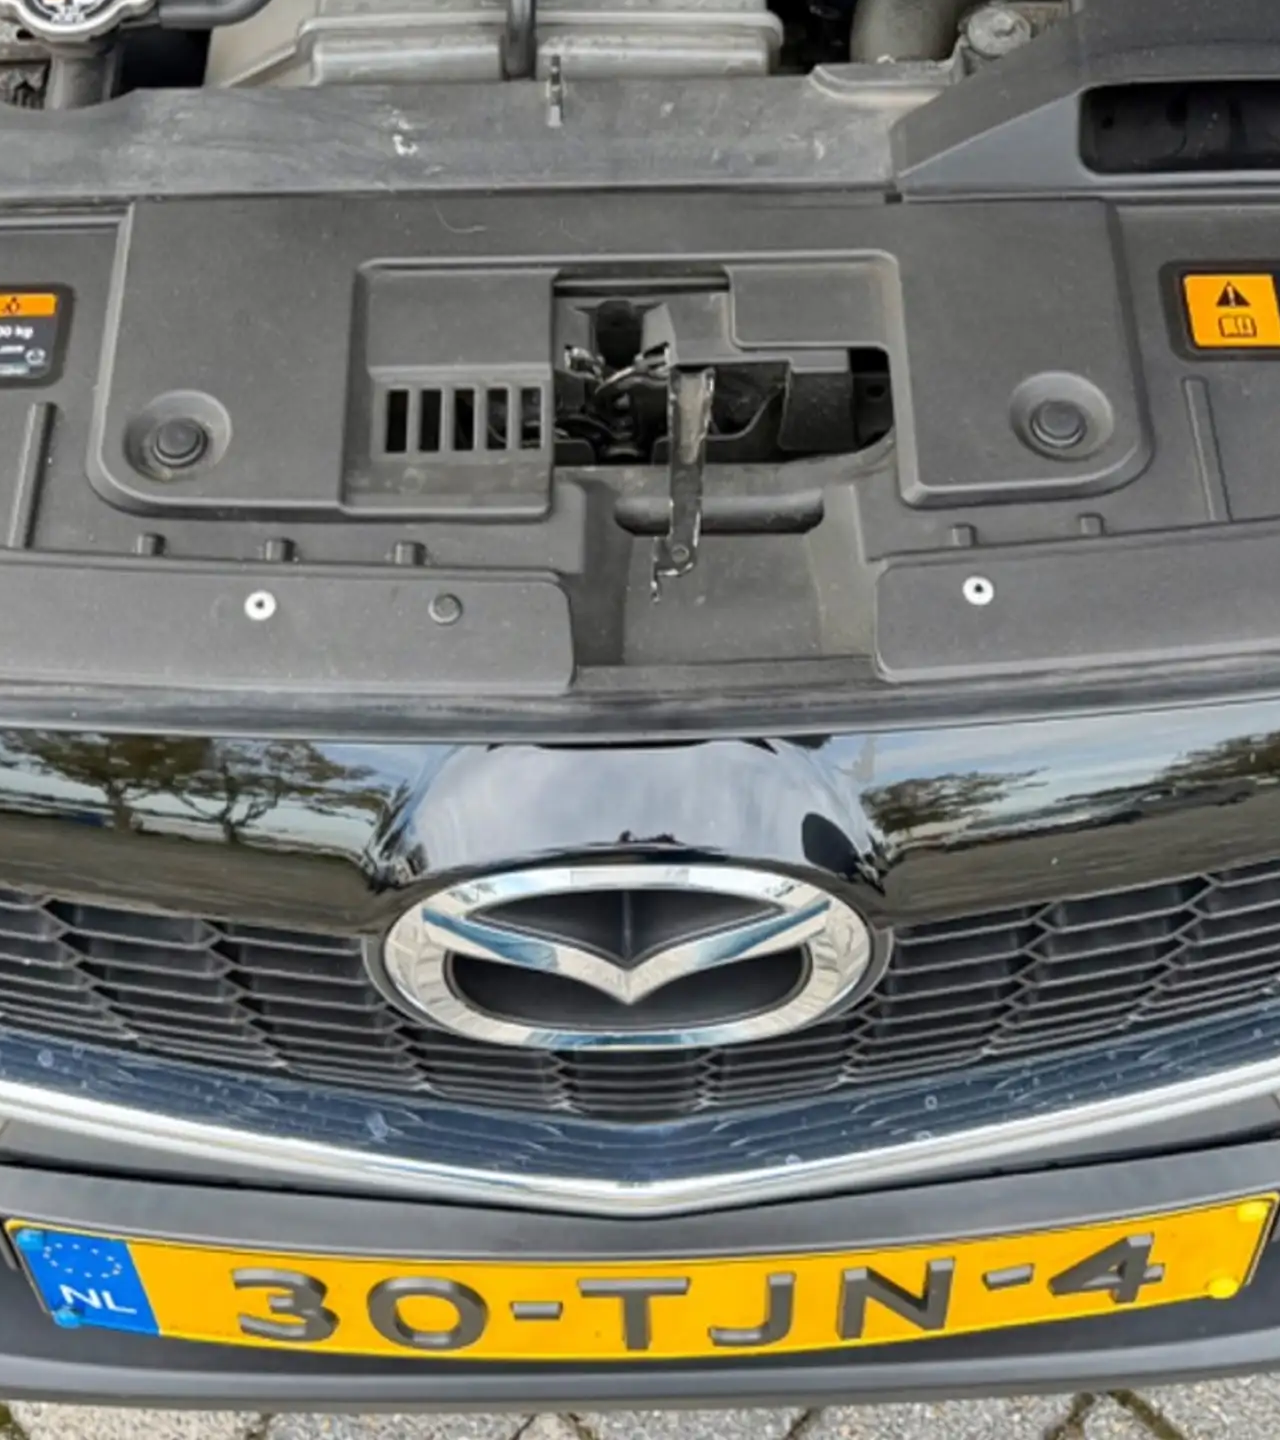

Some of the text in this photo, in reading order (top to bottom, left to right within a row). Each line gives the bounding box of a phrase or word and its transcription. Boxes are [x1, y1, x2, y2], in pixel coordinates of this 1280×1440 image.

[14, 325, 34, 340] kg
[58, 1283, 138, 1315] NL
[230, 1231, 1166, 1353] 30-TJN-4
